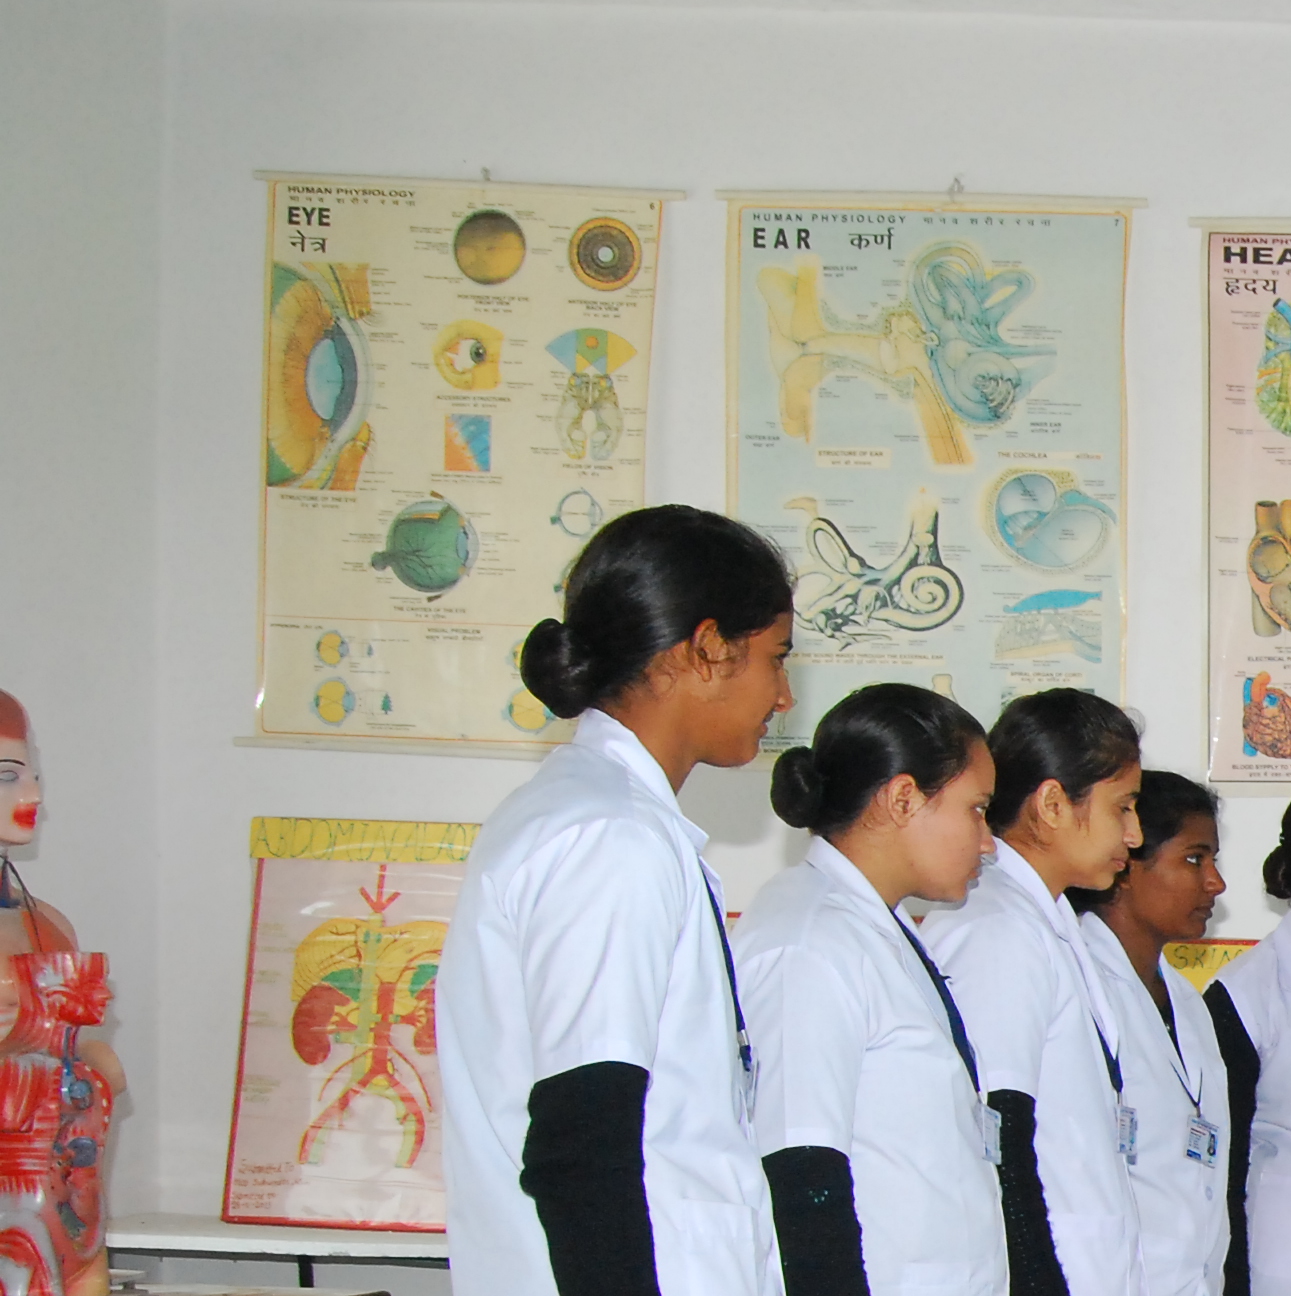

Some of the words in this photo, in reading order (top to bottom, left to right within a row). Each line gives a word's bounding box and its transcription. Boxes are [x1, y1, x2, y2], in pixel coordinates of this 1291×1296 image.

[288, 186, 332, 194] HUMAN
[336, 188, 415, 198] PHYSIOLOGY
[288, 206, 331, 227] EYE
[753, 213, 803, 222] HUMAN
[811, 214, 907, 224] PHYSIOLOGY
[289, 230, 327, 253] नेत्र
[753, 227, 811, 250] EAR
[849, 227, 894, 250] कर्ण
[1222, 237, 1268, 245] HUMAN
[1223, 276, 1278, 296] हृदय
